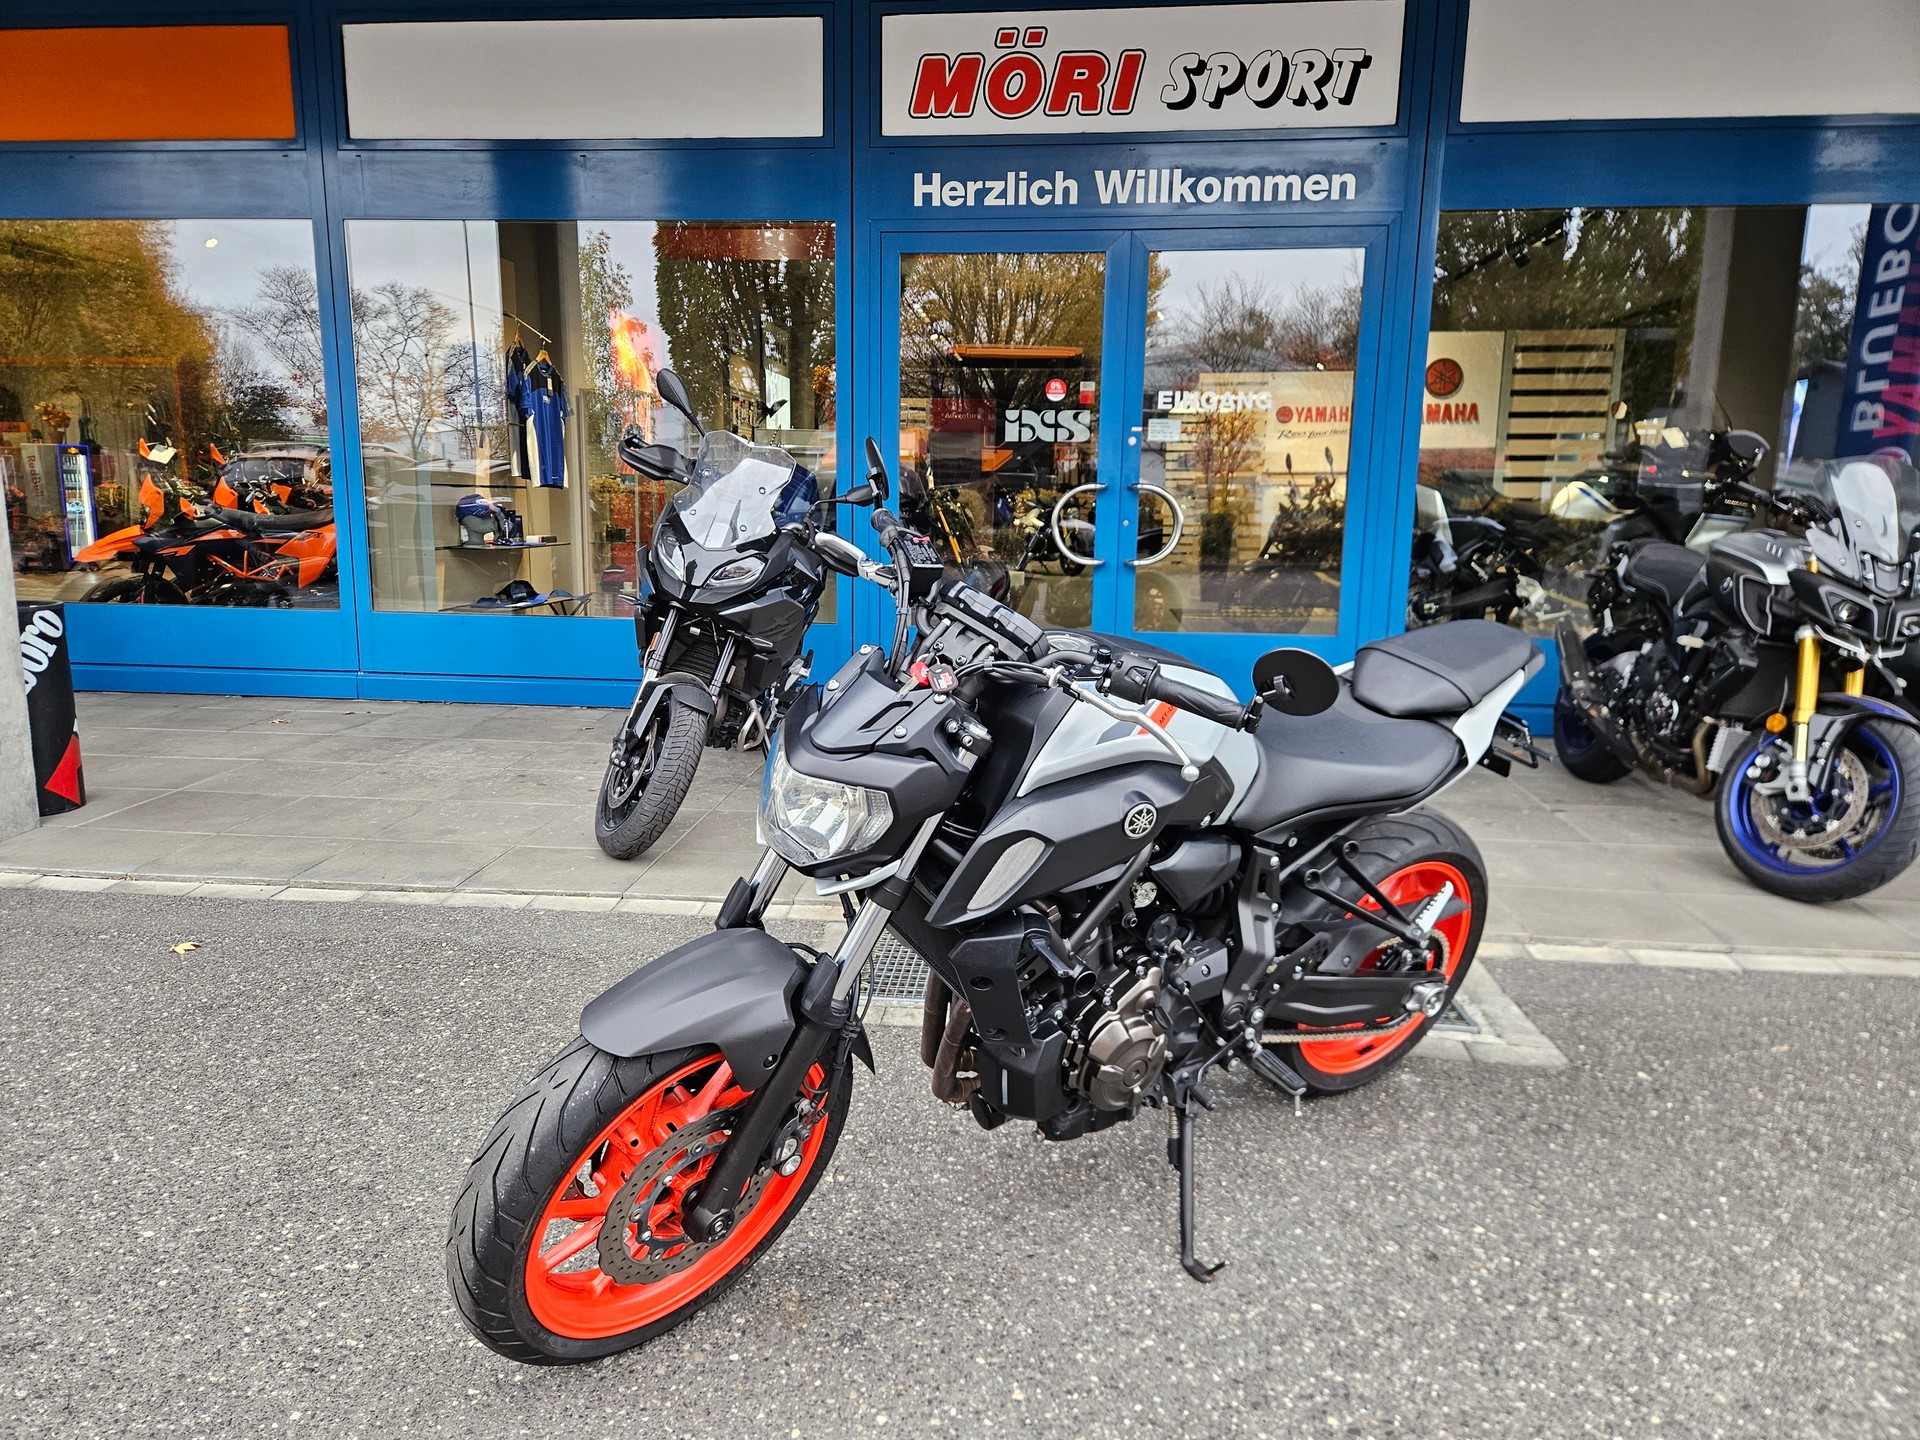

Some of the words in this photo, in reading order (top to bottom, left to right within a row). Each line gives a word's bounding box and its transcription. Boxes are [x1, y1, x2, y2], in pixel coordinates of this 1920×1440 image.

[908, 26, 1147, 119] MÖRI
[1160, 49, 1373, 111] SPORT
[914, 170, 1078, 206] Herzlich
[1094, 168, 1356, 205] Willkommen
[1157, 390, 1273, 411] EINGANG
[1421, 402, 1480, 424] MAHA
